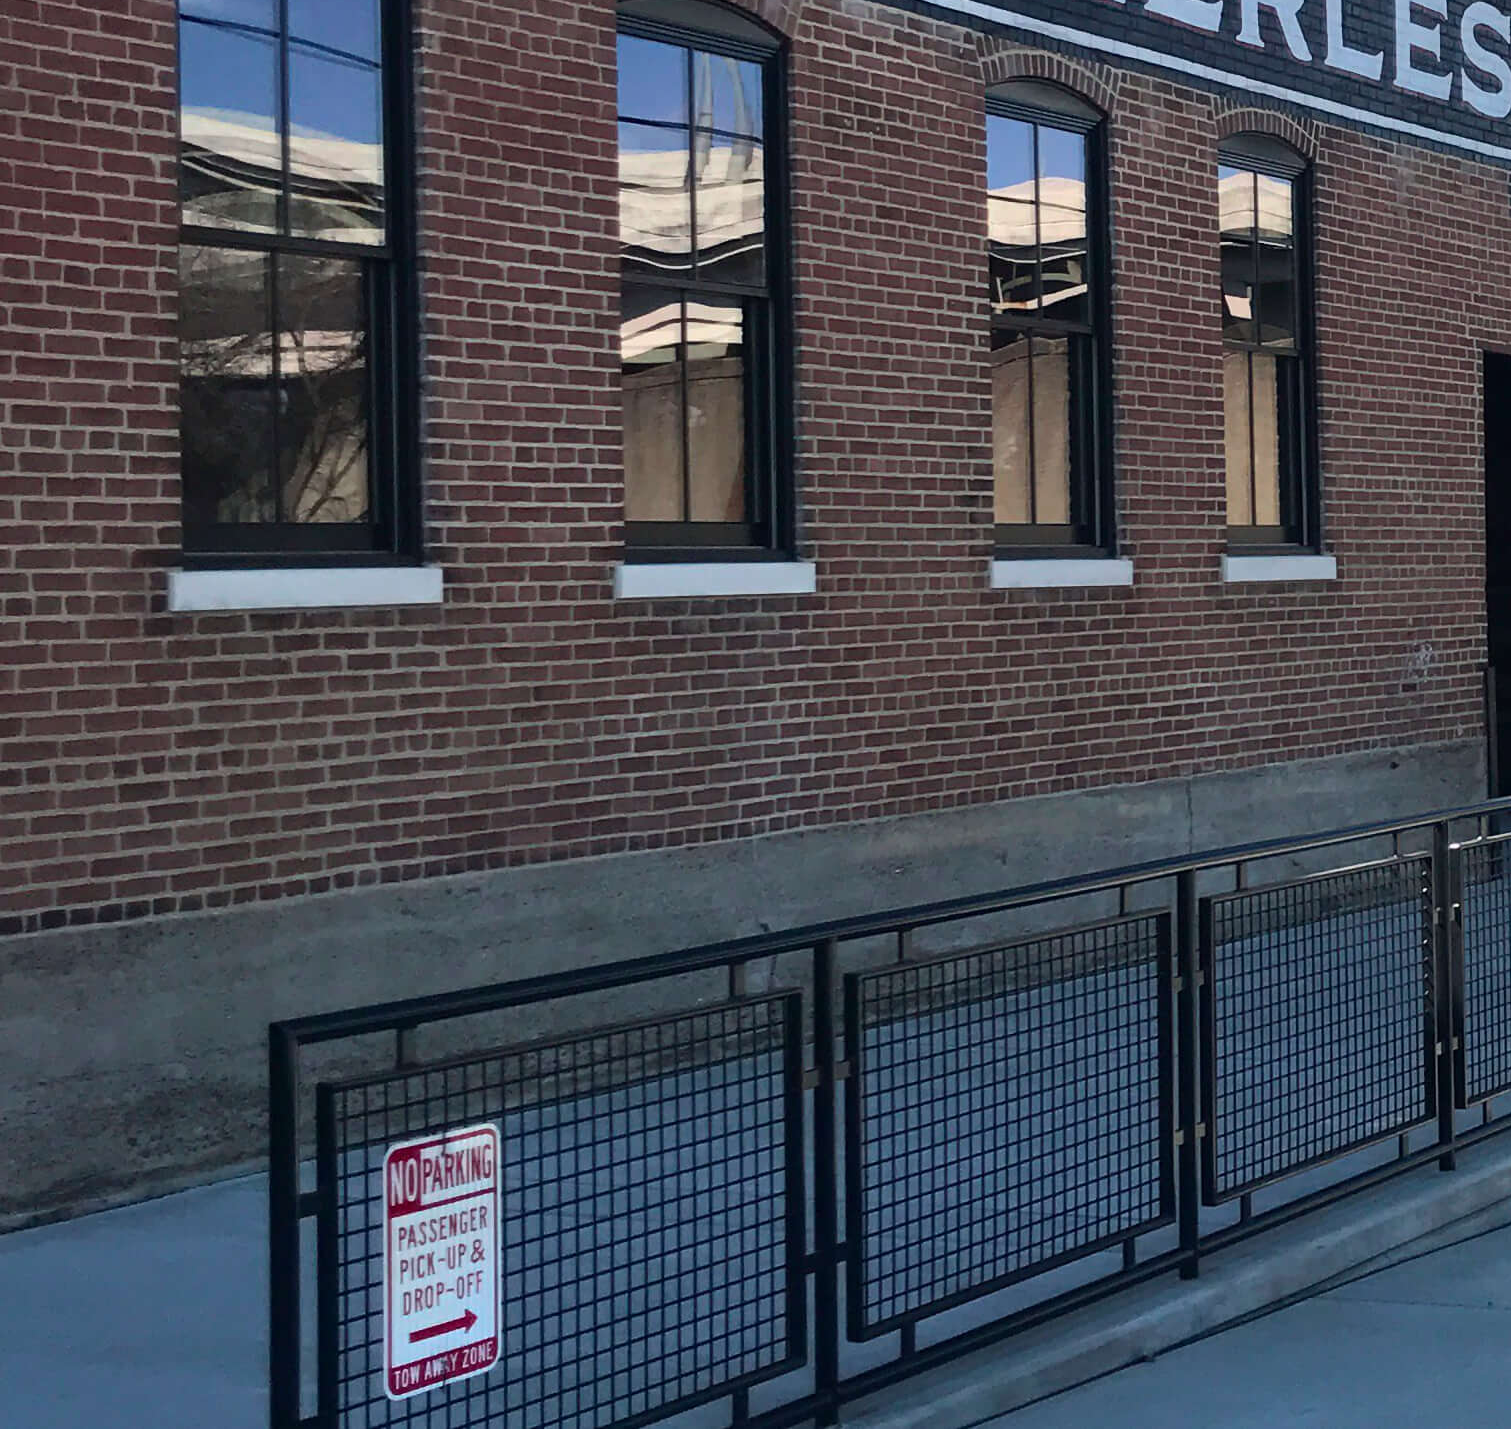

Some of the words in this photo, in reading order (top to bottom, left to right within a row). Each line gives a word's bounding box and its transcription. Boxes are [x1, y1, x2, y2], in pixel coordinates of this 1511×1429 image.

[390, 1157, 418, 1206] NO
[422, 1144, 492, 1194] PARKING
[398, 1206, 487, 1251] PASSENGER
[400, 1243, 466, 1284] PICK-UP
[470, 1239, 485, 1263] &
[402, 1270, 483, 1315] DROP-OFF
[393, 1365, 420, 1389] TOW
[462, 1341, 494, 1368] ZONE
